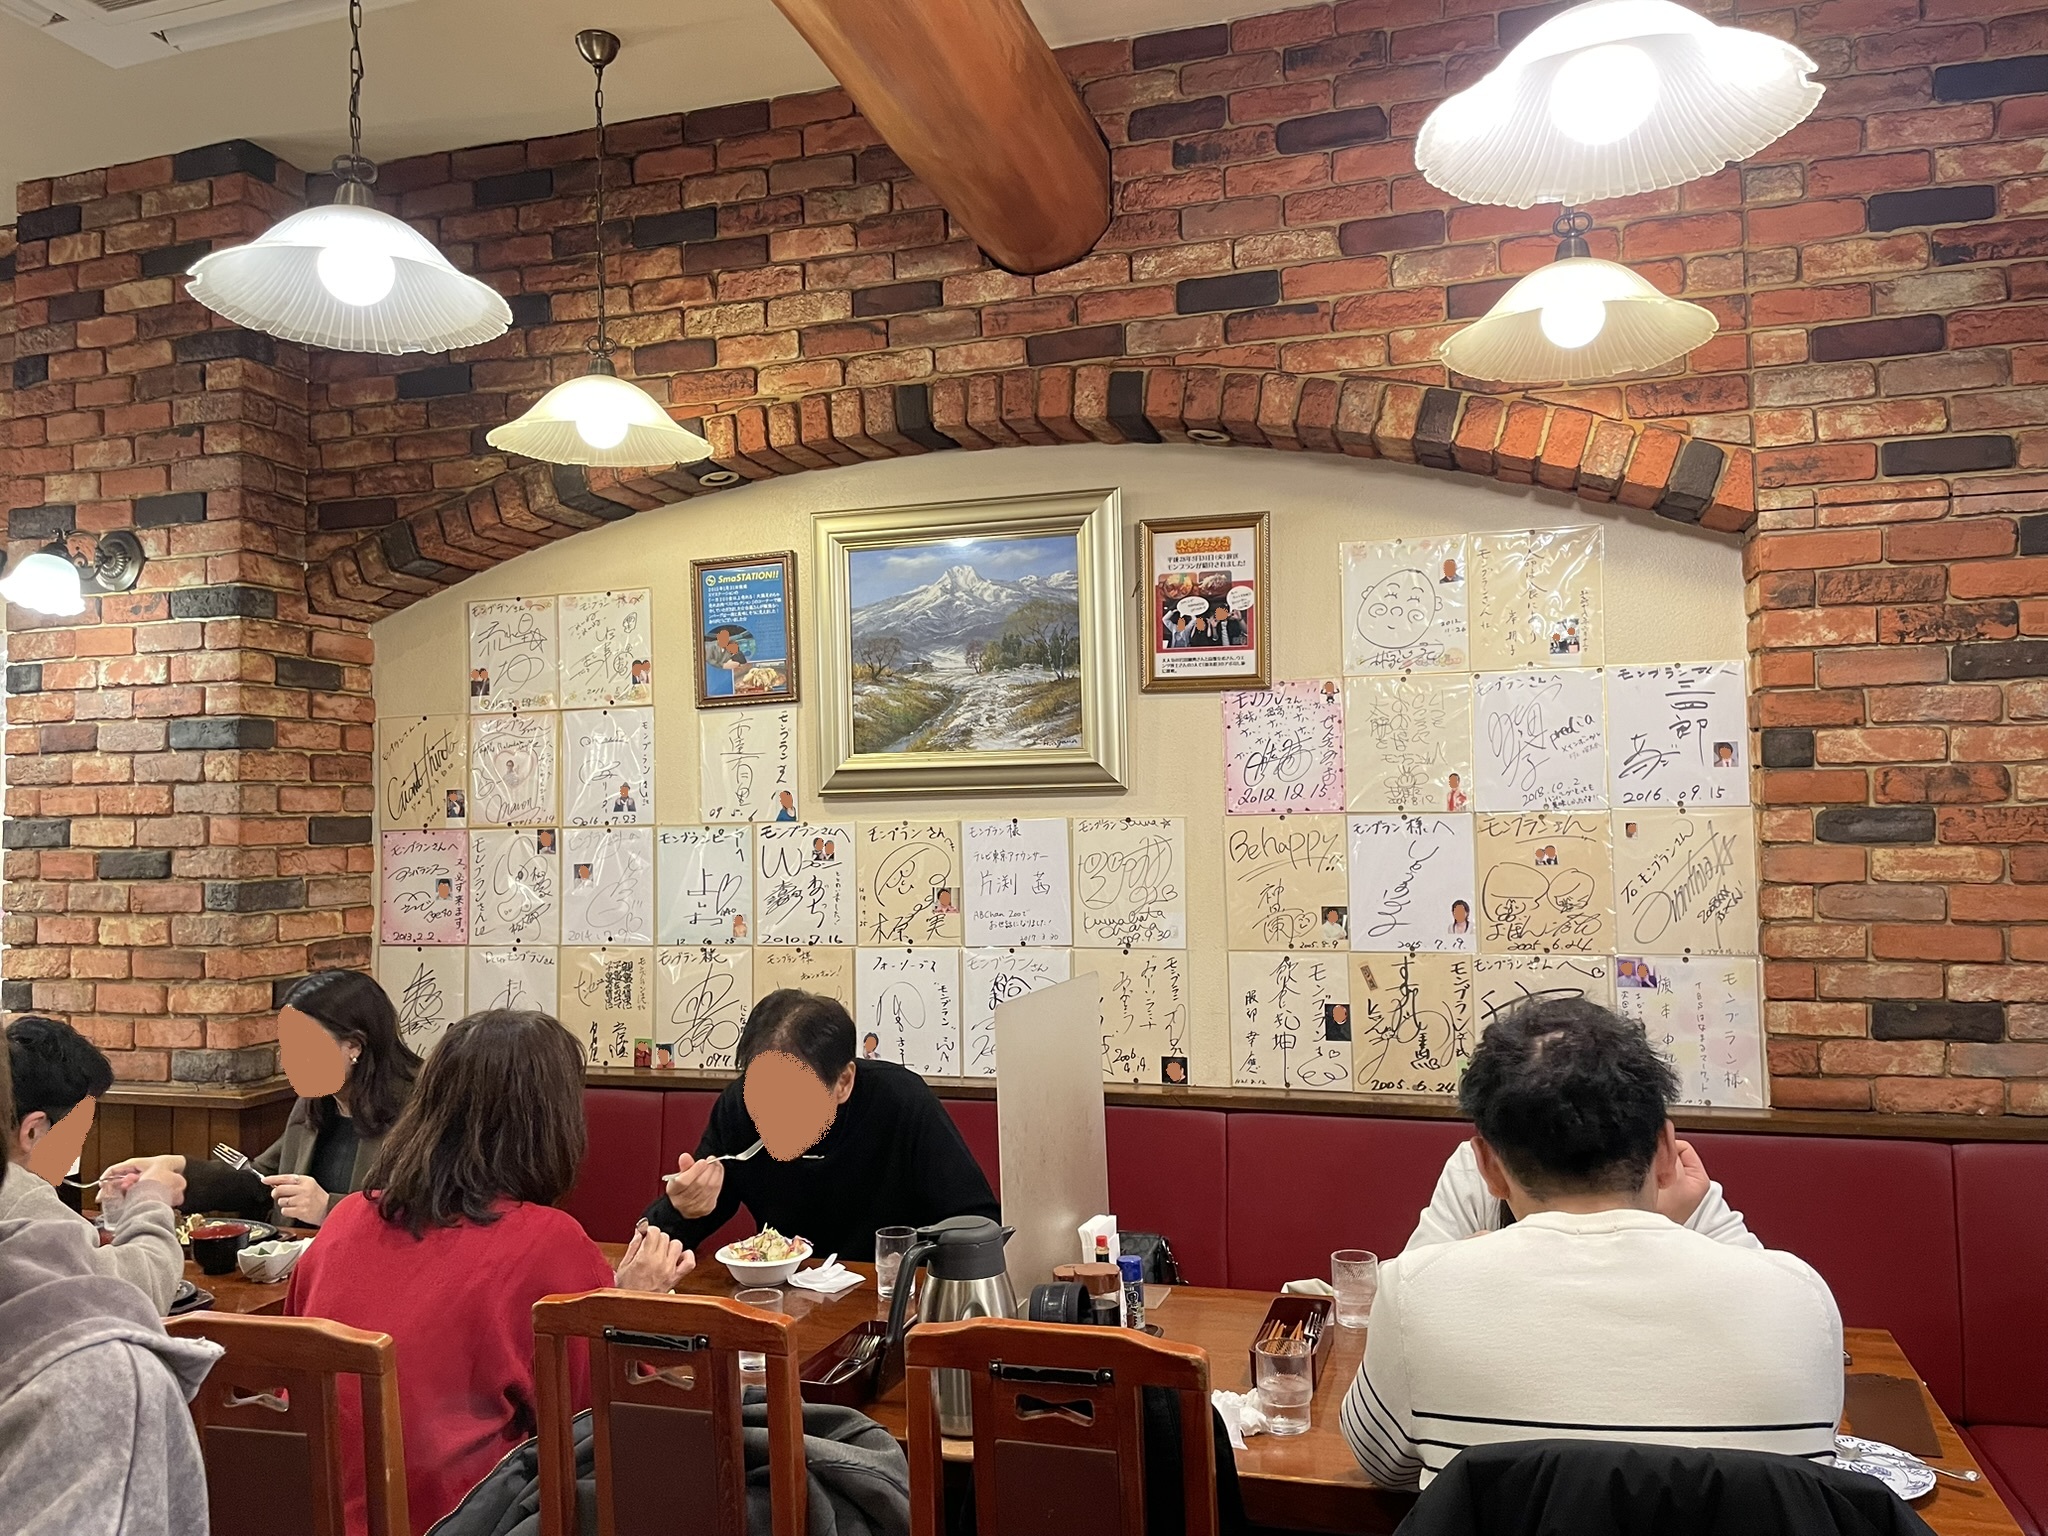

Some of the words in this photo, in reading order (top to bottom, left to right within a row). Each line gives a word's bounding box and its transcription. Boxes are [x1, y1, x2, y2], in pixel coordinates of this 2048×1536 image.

[718, 571, 779, 584] SmaSTATION!!
[968, 825, 1022, 838] モンブラン様
[1722, 972, 1745, 1089] モンブラン様
